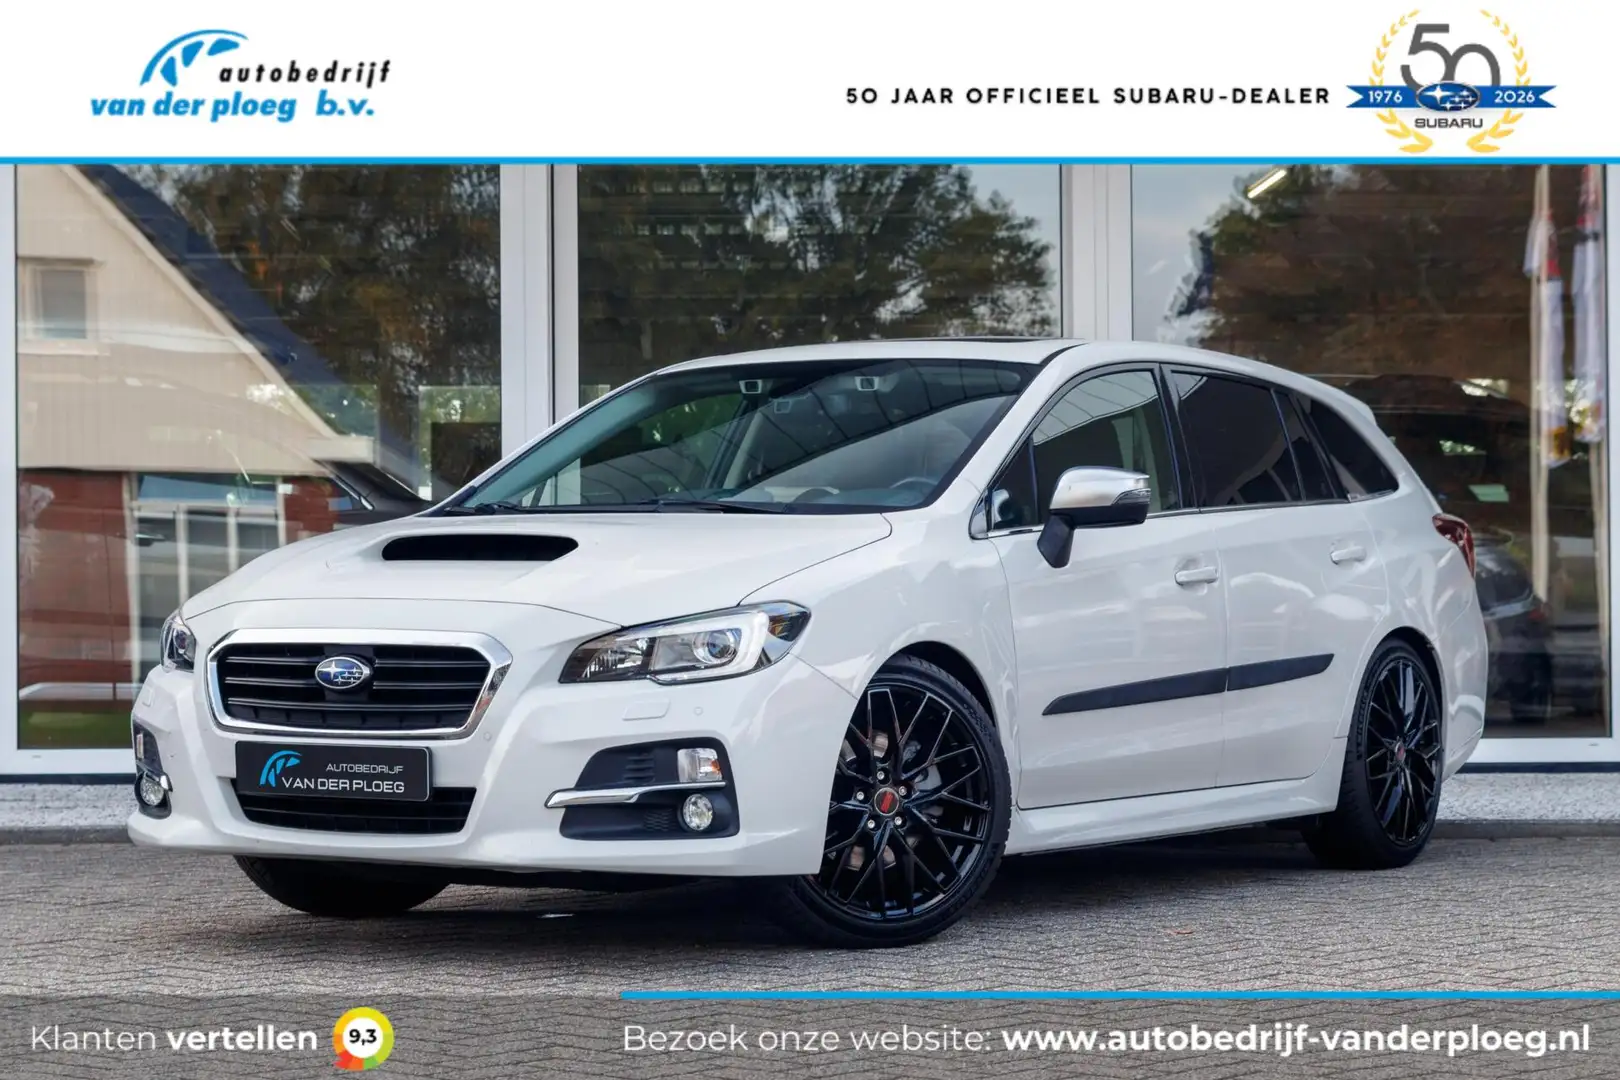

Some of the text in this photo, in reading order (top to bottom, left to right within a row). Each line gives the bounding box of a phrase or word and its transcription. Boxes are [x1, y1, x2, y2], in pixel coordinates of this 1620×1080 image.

[325, 763, 404, 775] AUTOBEDRIJF
[281, 777, 405, 793] VAN DER PLOEG
